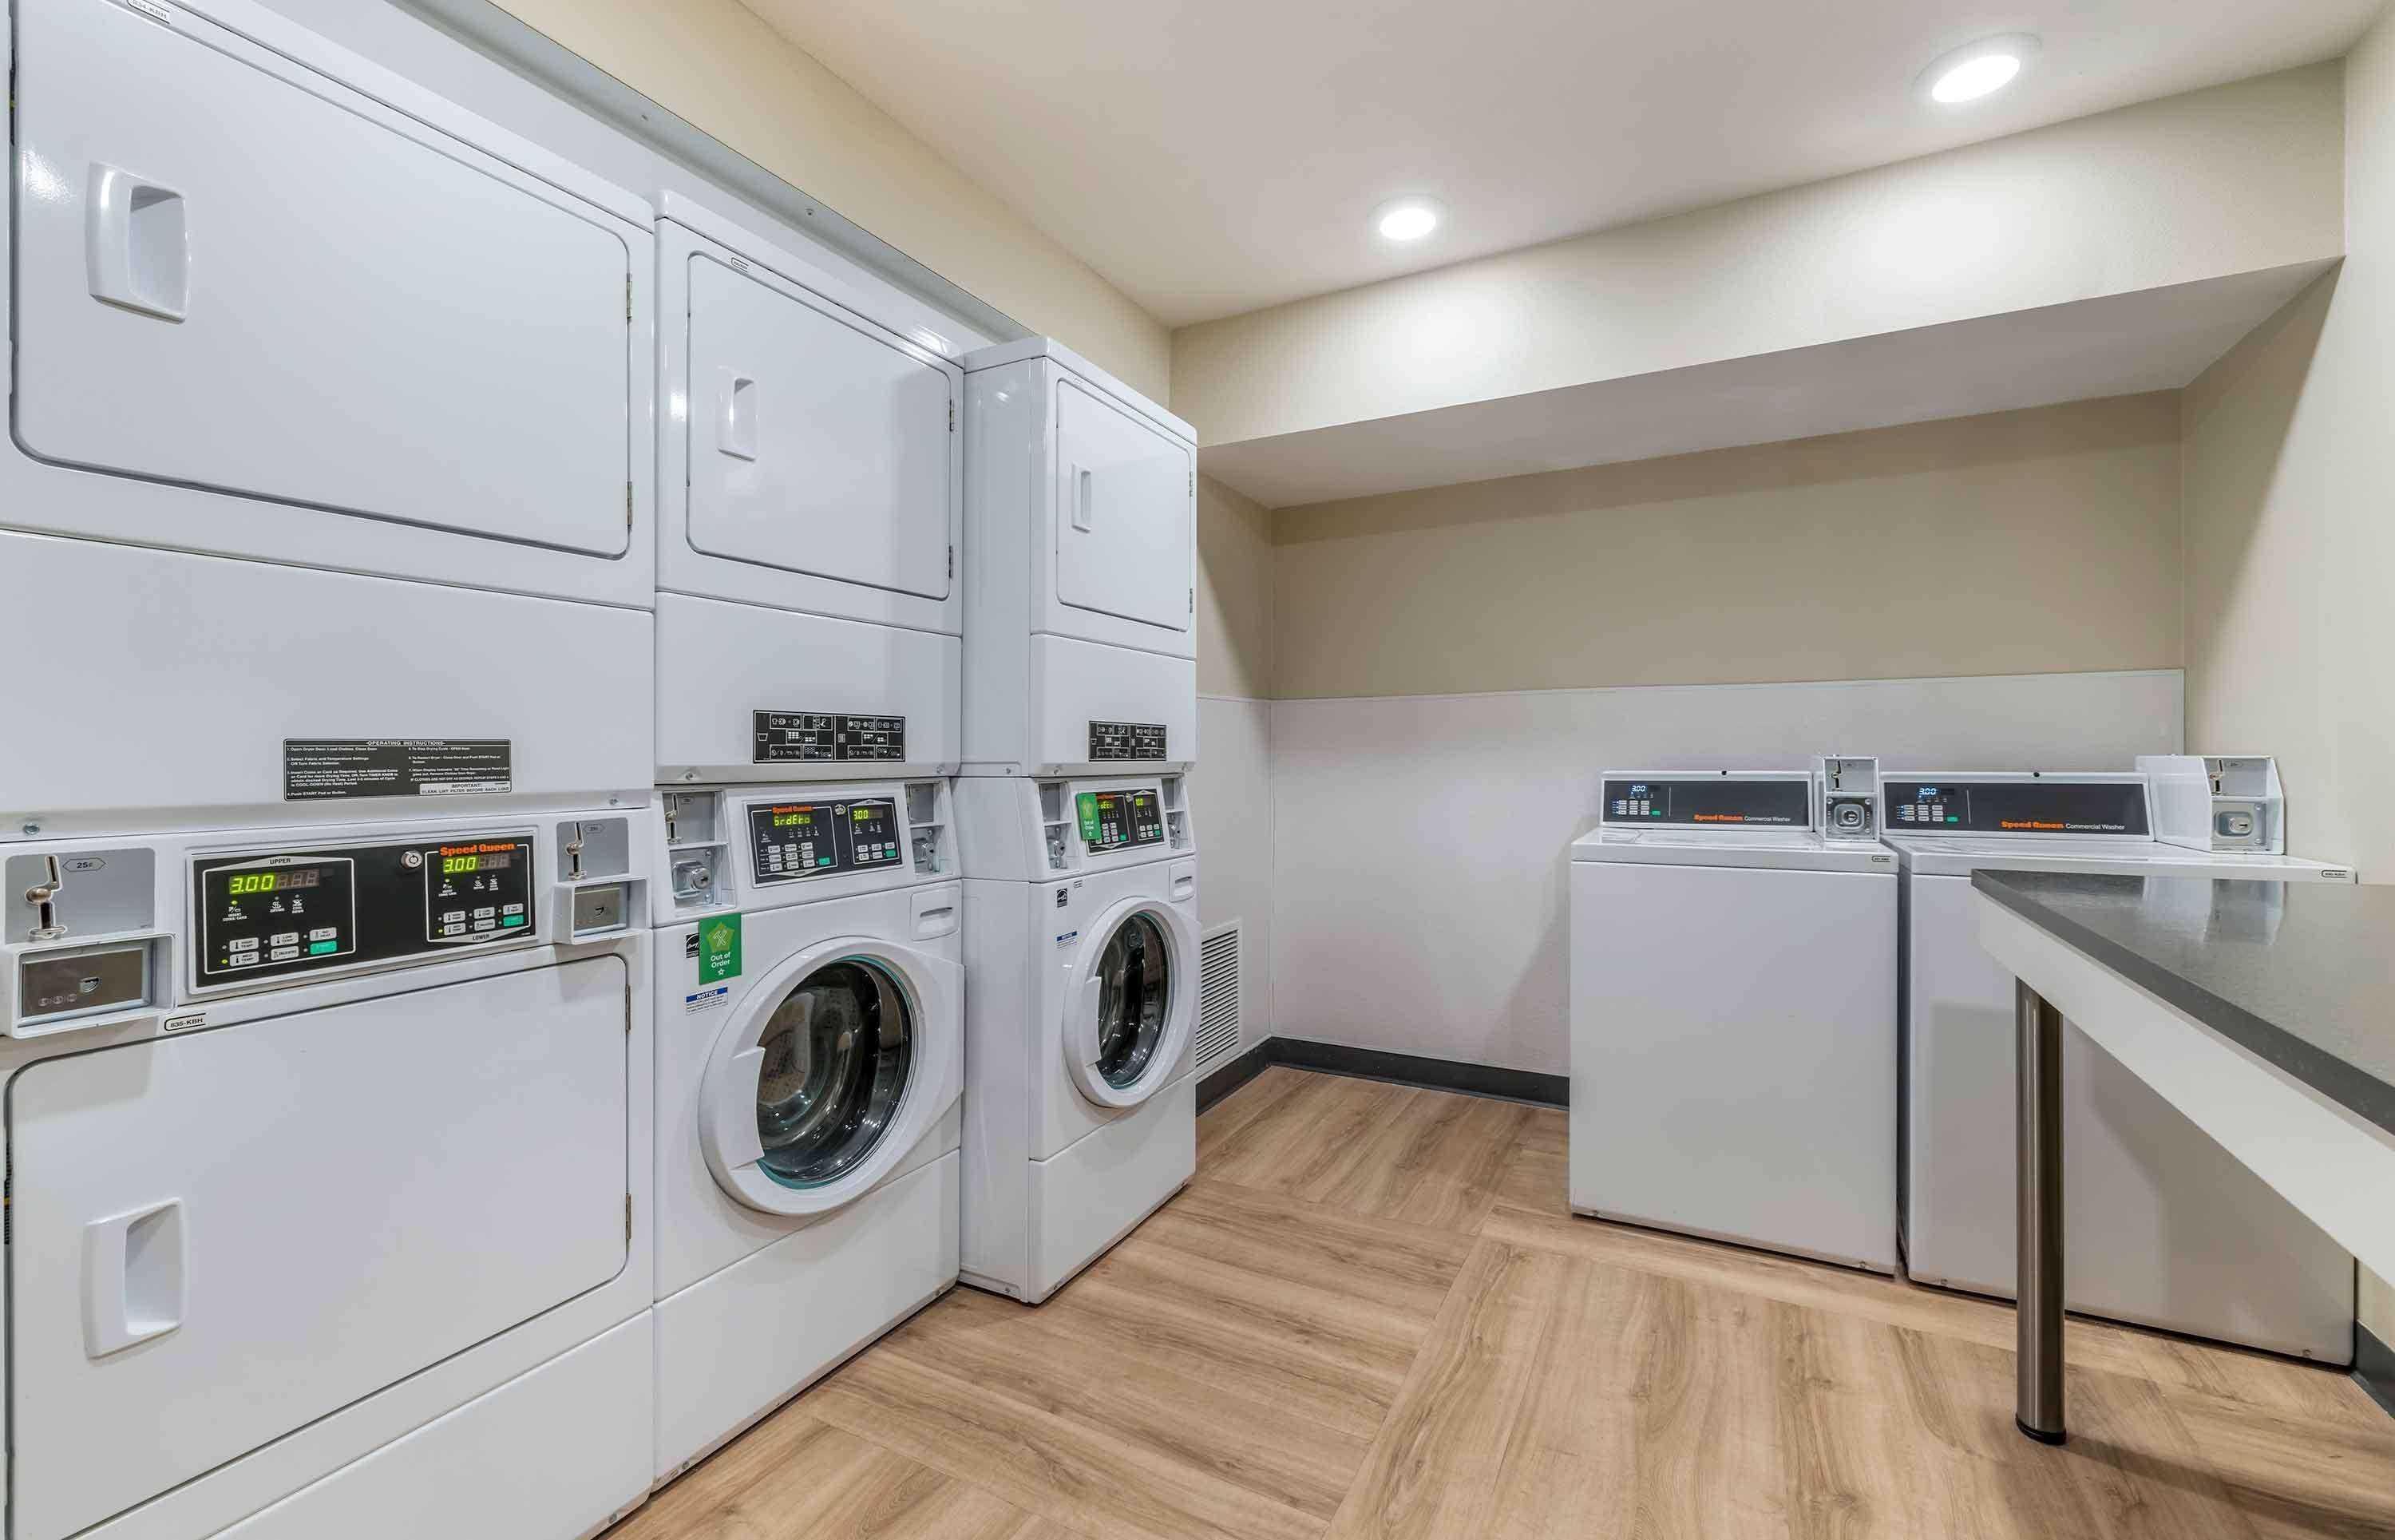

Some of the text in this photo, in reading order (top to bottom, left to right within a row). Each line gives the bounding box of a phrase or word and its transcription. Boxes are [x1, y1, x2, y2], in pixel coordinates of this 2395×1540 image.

[440, 843, 515, 856] Speed Queen
[443, 857, 477, 873] 3.00
[231, 874, 275, 894] 3.00
[696, 991, 718, 1000] NOTICE
